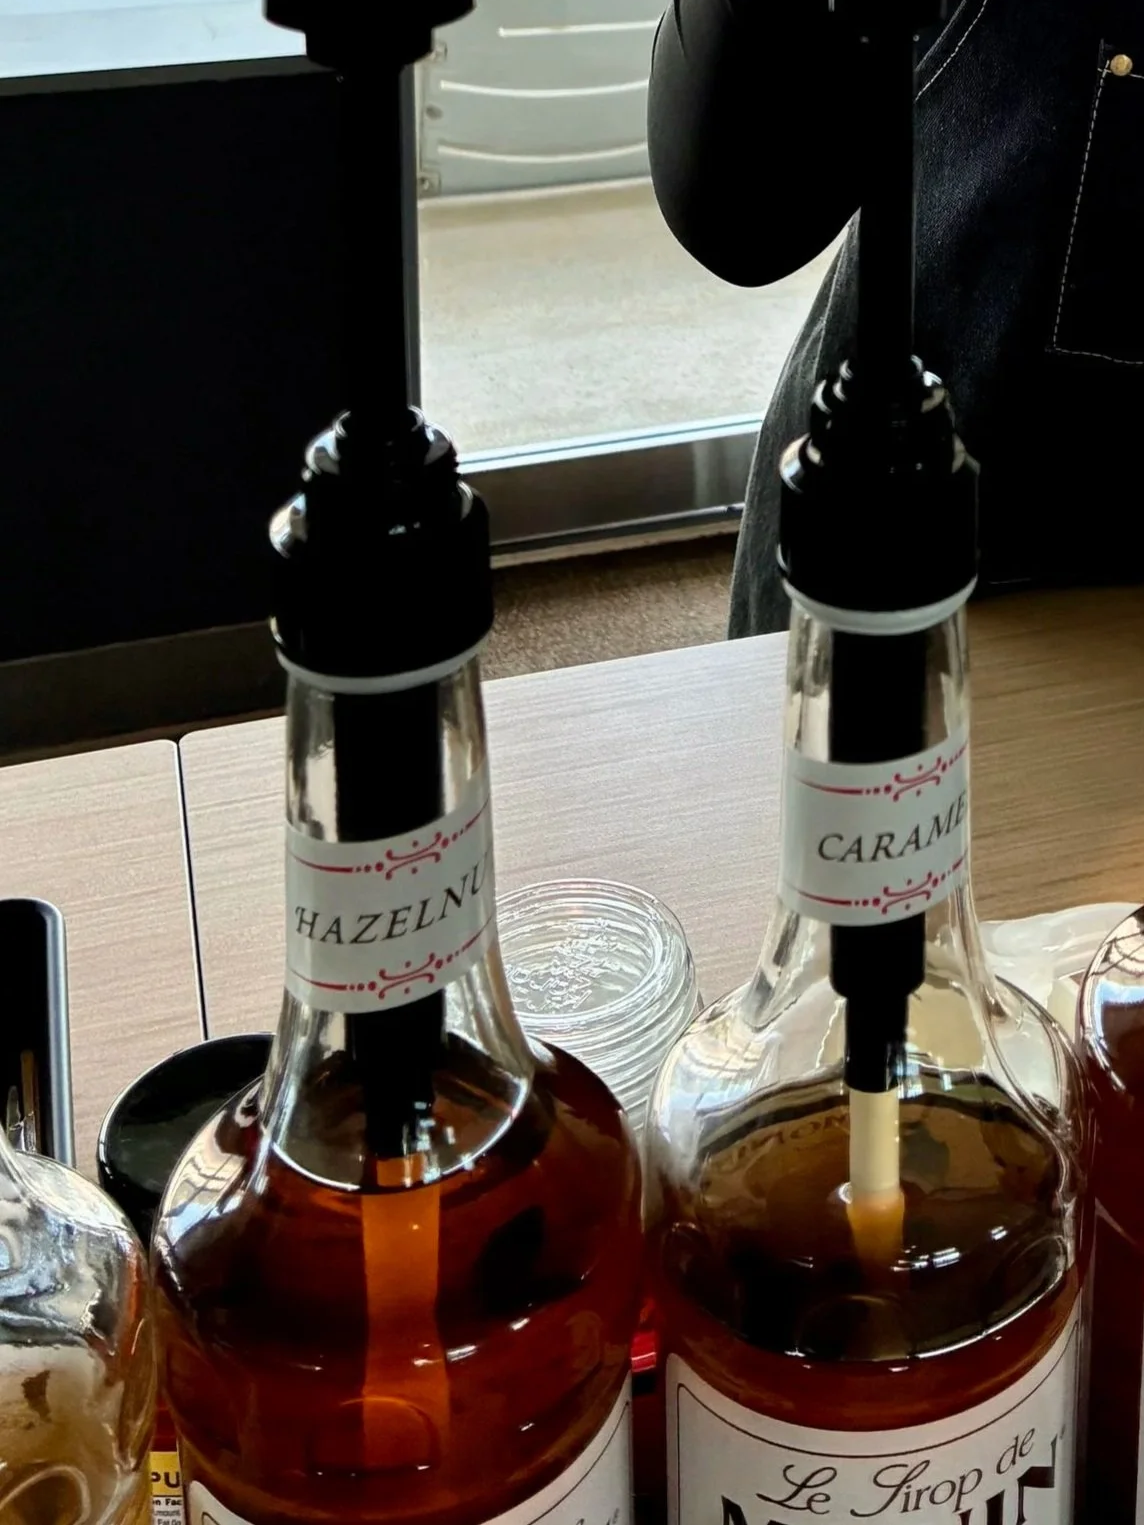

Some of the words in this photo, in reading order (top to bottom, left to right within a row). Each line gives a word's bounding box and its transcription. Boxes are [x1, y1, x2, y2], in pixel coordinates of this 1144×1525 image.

[756, 1463, 838, 1516] Le
[850, 1459, 982, 1517] Sirop
[996, 1427, 1036, 1475] de
